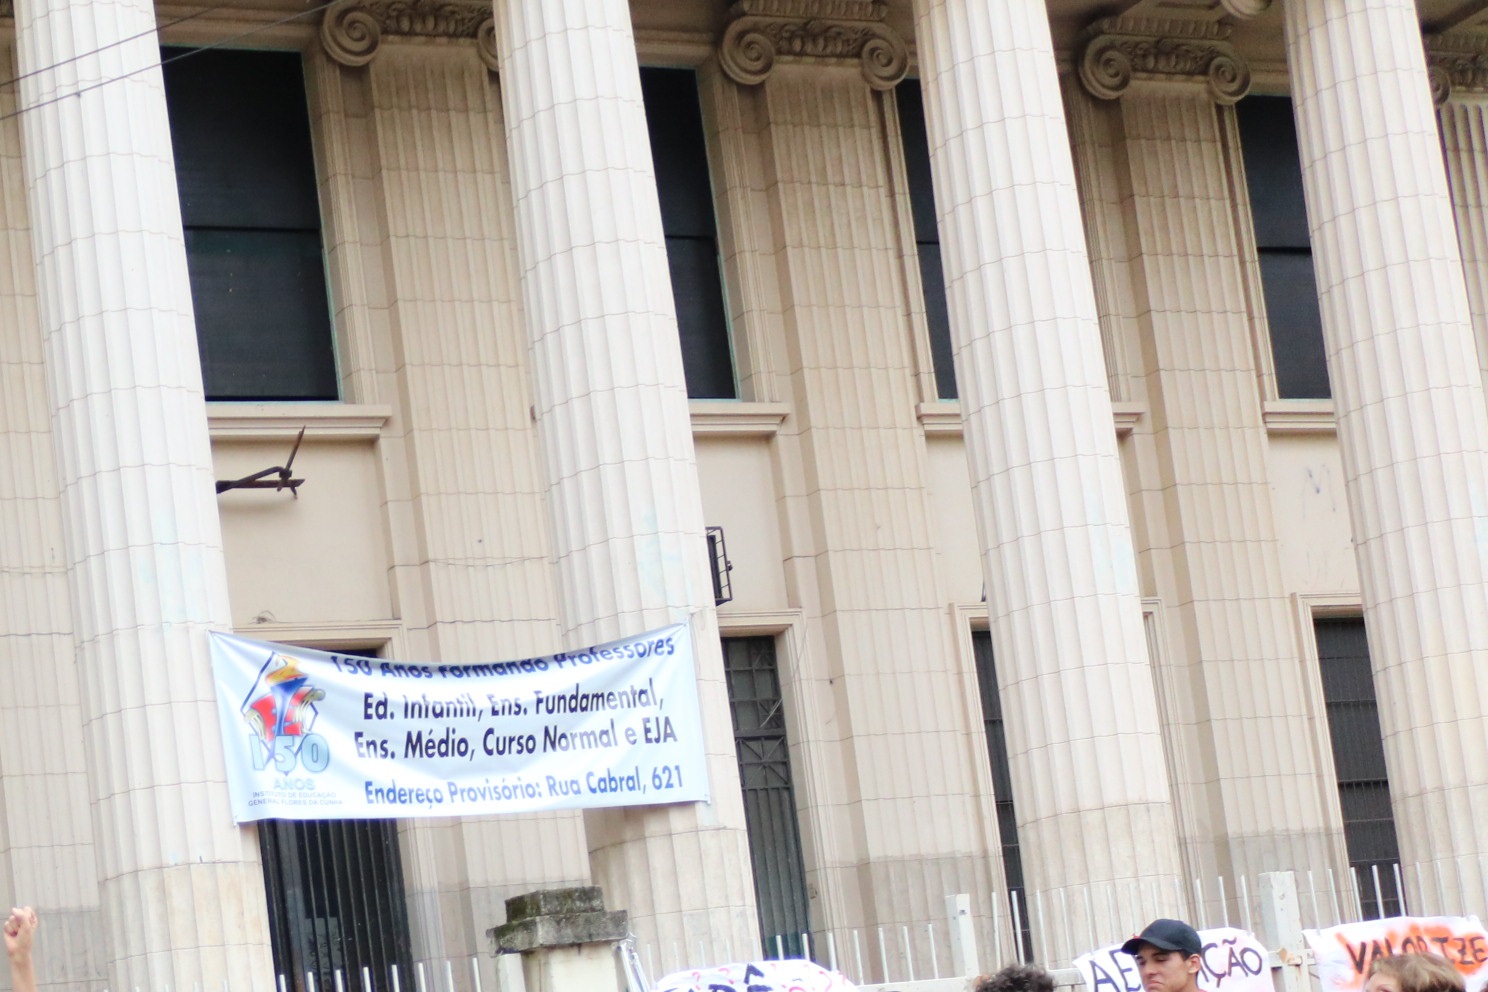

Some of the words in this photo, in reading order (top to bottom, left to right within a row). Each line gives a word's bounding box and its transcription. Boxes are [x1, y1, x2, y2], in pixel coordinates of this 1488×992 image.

[331, 656, 372, 676] 150
[380, 662, 434, 679] Anos
[553, 637, 675, 669] Professores
[363, 692, 395, 720] Ed.
[403, 693, 483, 722] Infantil,
[487, 694, 527, 716] Ens.
[534, 677, 664, 715] Fundamental,
[249, 733, 330, 773] 150
[354, 731, 395, 759] Ens.
[404, 727, 475, 761] Médio,
[483, 727, 536, 756] Curso
[543, 718, 618, 753] Normal
[625, 726, 637, 745] e
[642, 716, 678, 744] EJA
[273, 778, 316, 791] ANOS
[365, 779, 444, 809] Endereço
[447, 776, 542, 803] Provisório:
[546, 775, 581, 797] Rua
[586, 766, 647, 794] Cabral,
[652, 765, 683, 790] 621
